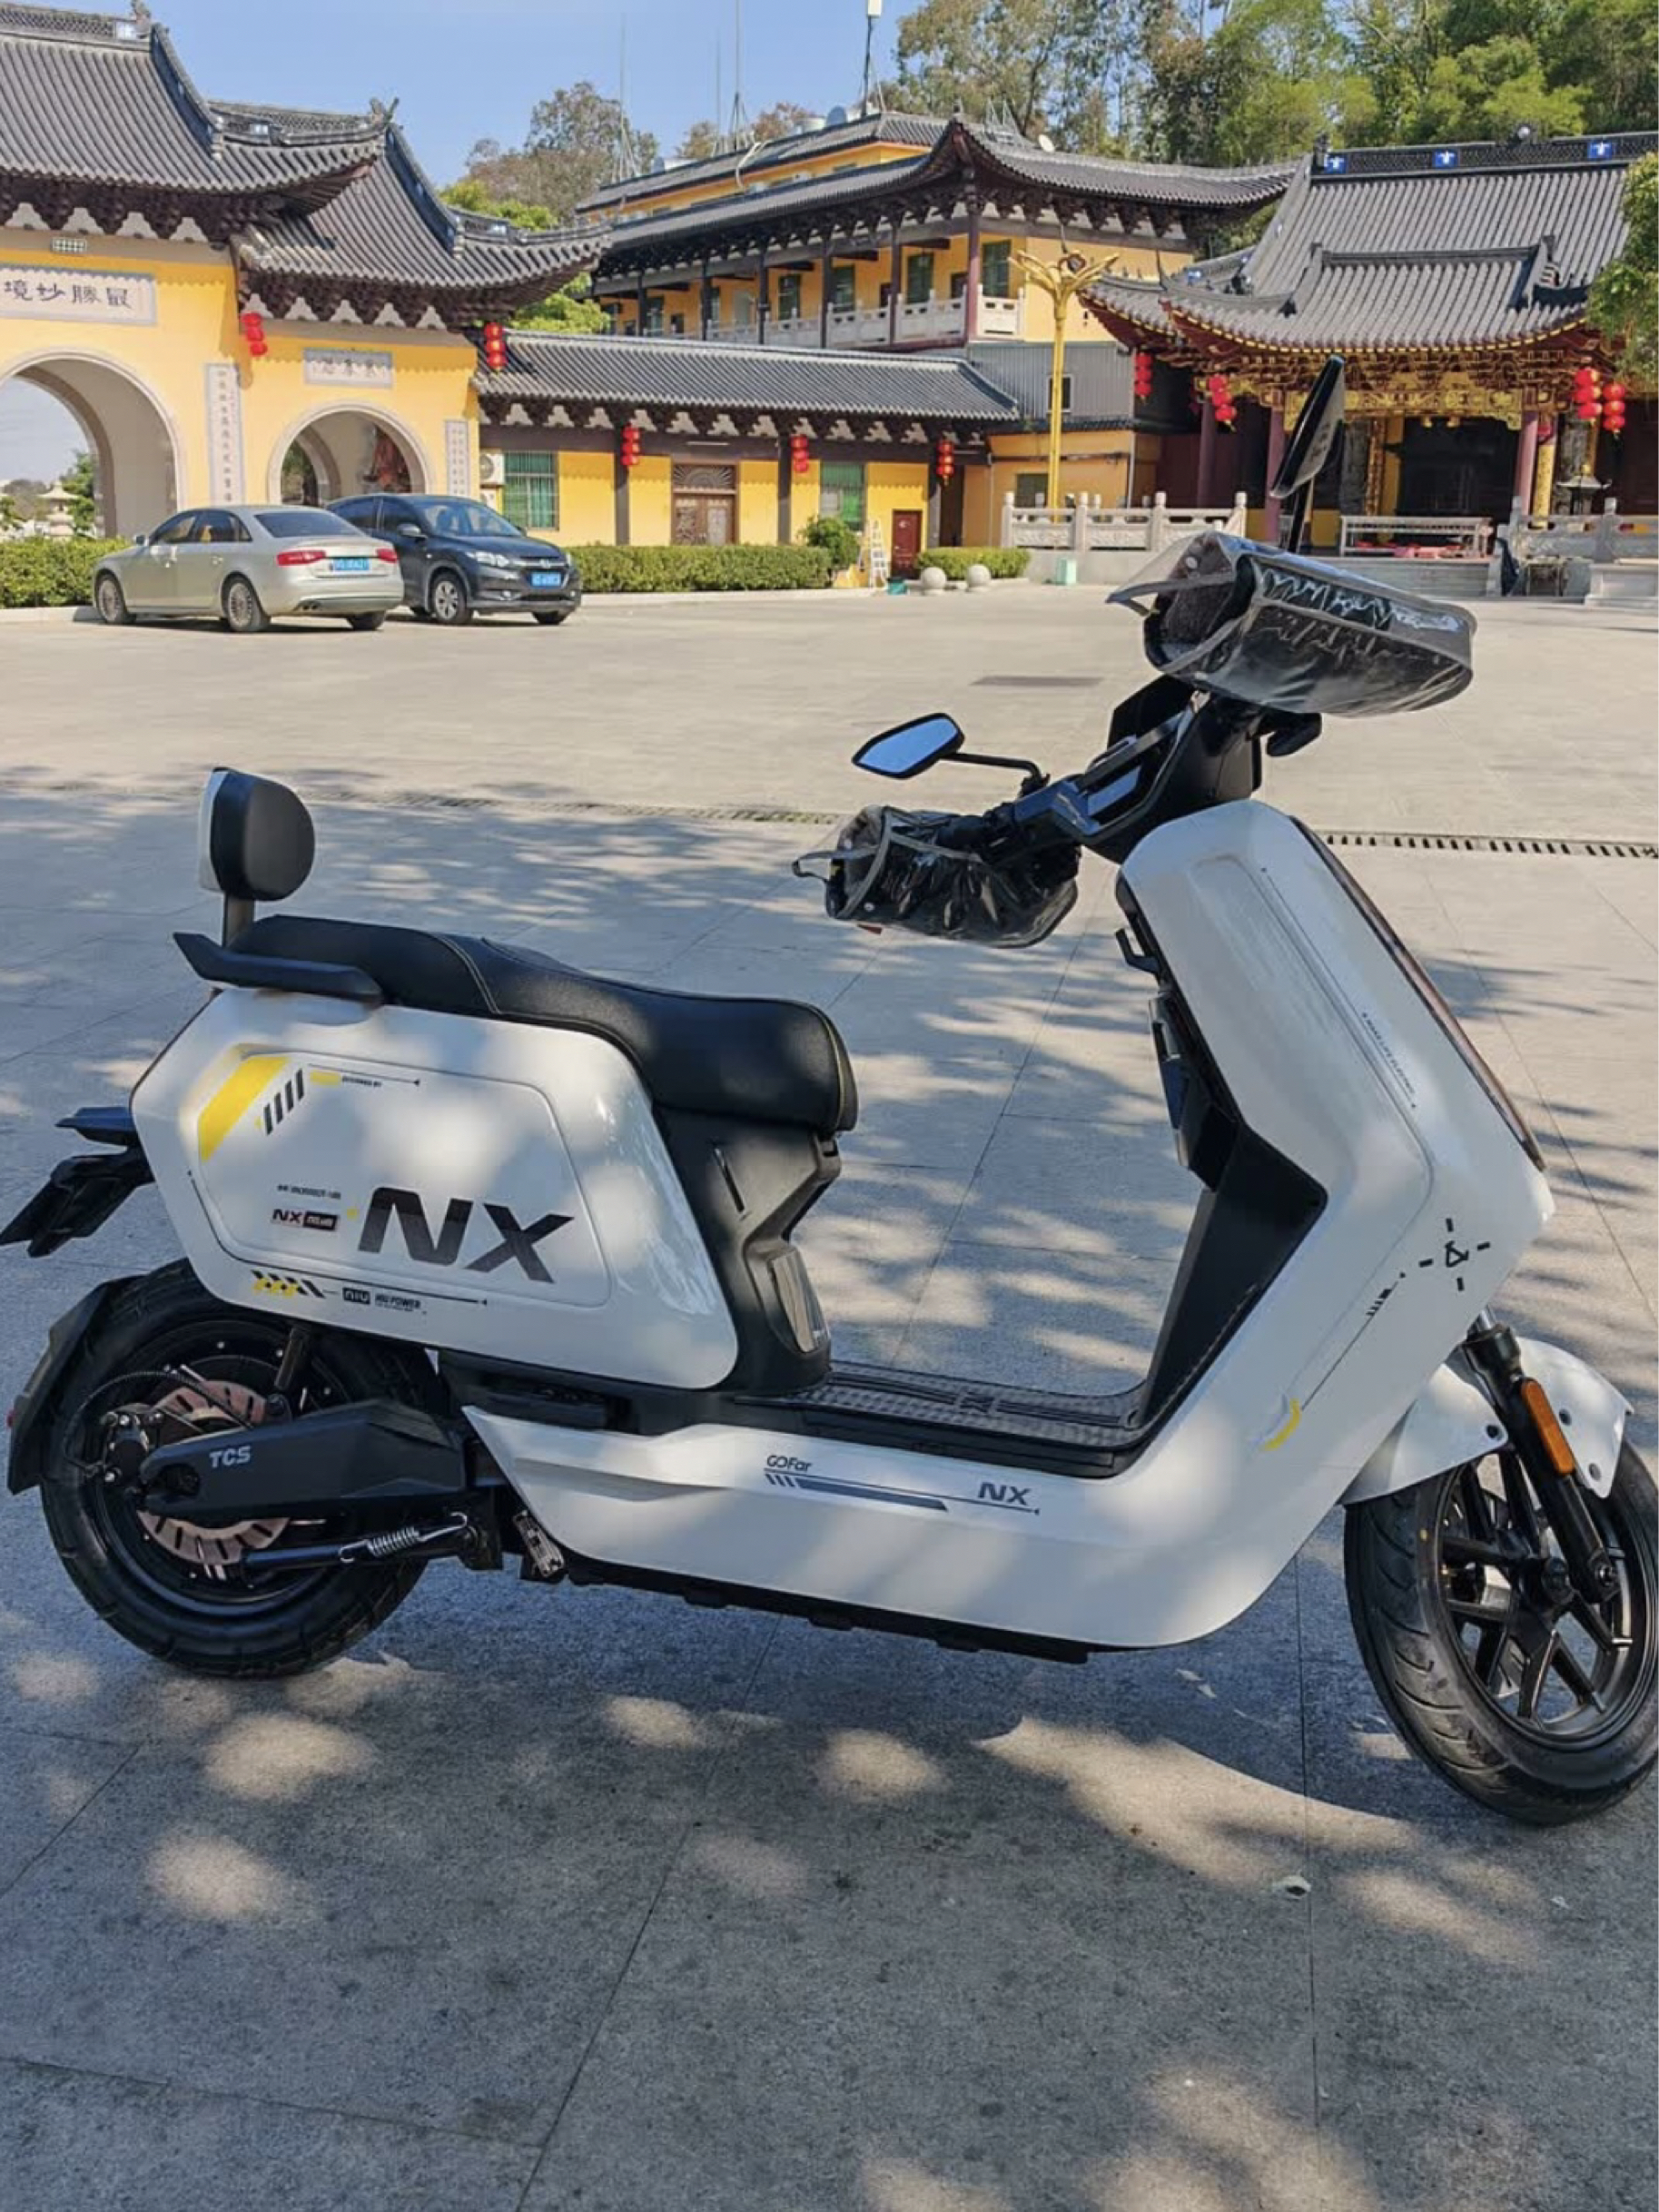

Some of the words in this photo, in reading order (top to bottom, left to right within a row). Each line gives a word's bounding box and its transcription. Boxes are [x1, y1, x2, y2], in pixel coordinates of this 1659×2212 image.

[272, 1209, 303, 1225] NX
[358, 1187, 575, 1284] NX
[209, 1445, 252, 1468] TCS
[978, 1481, 1032, 1506] NX
